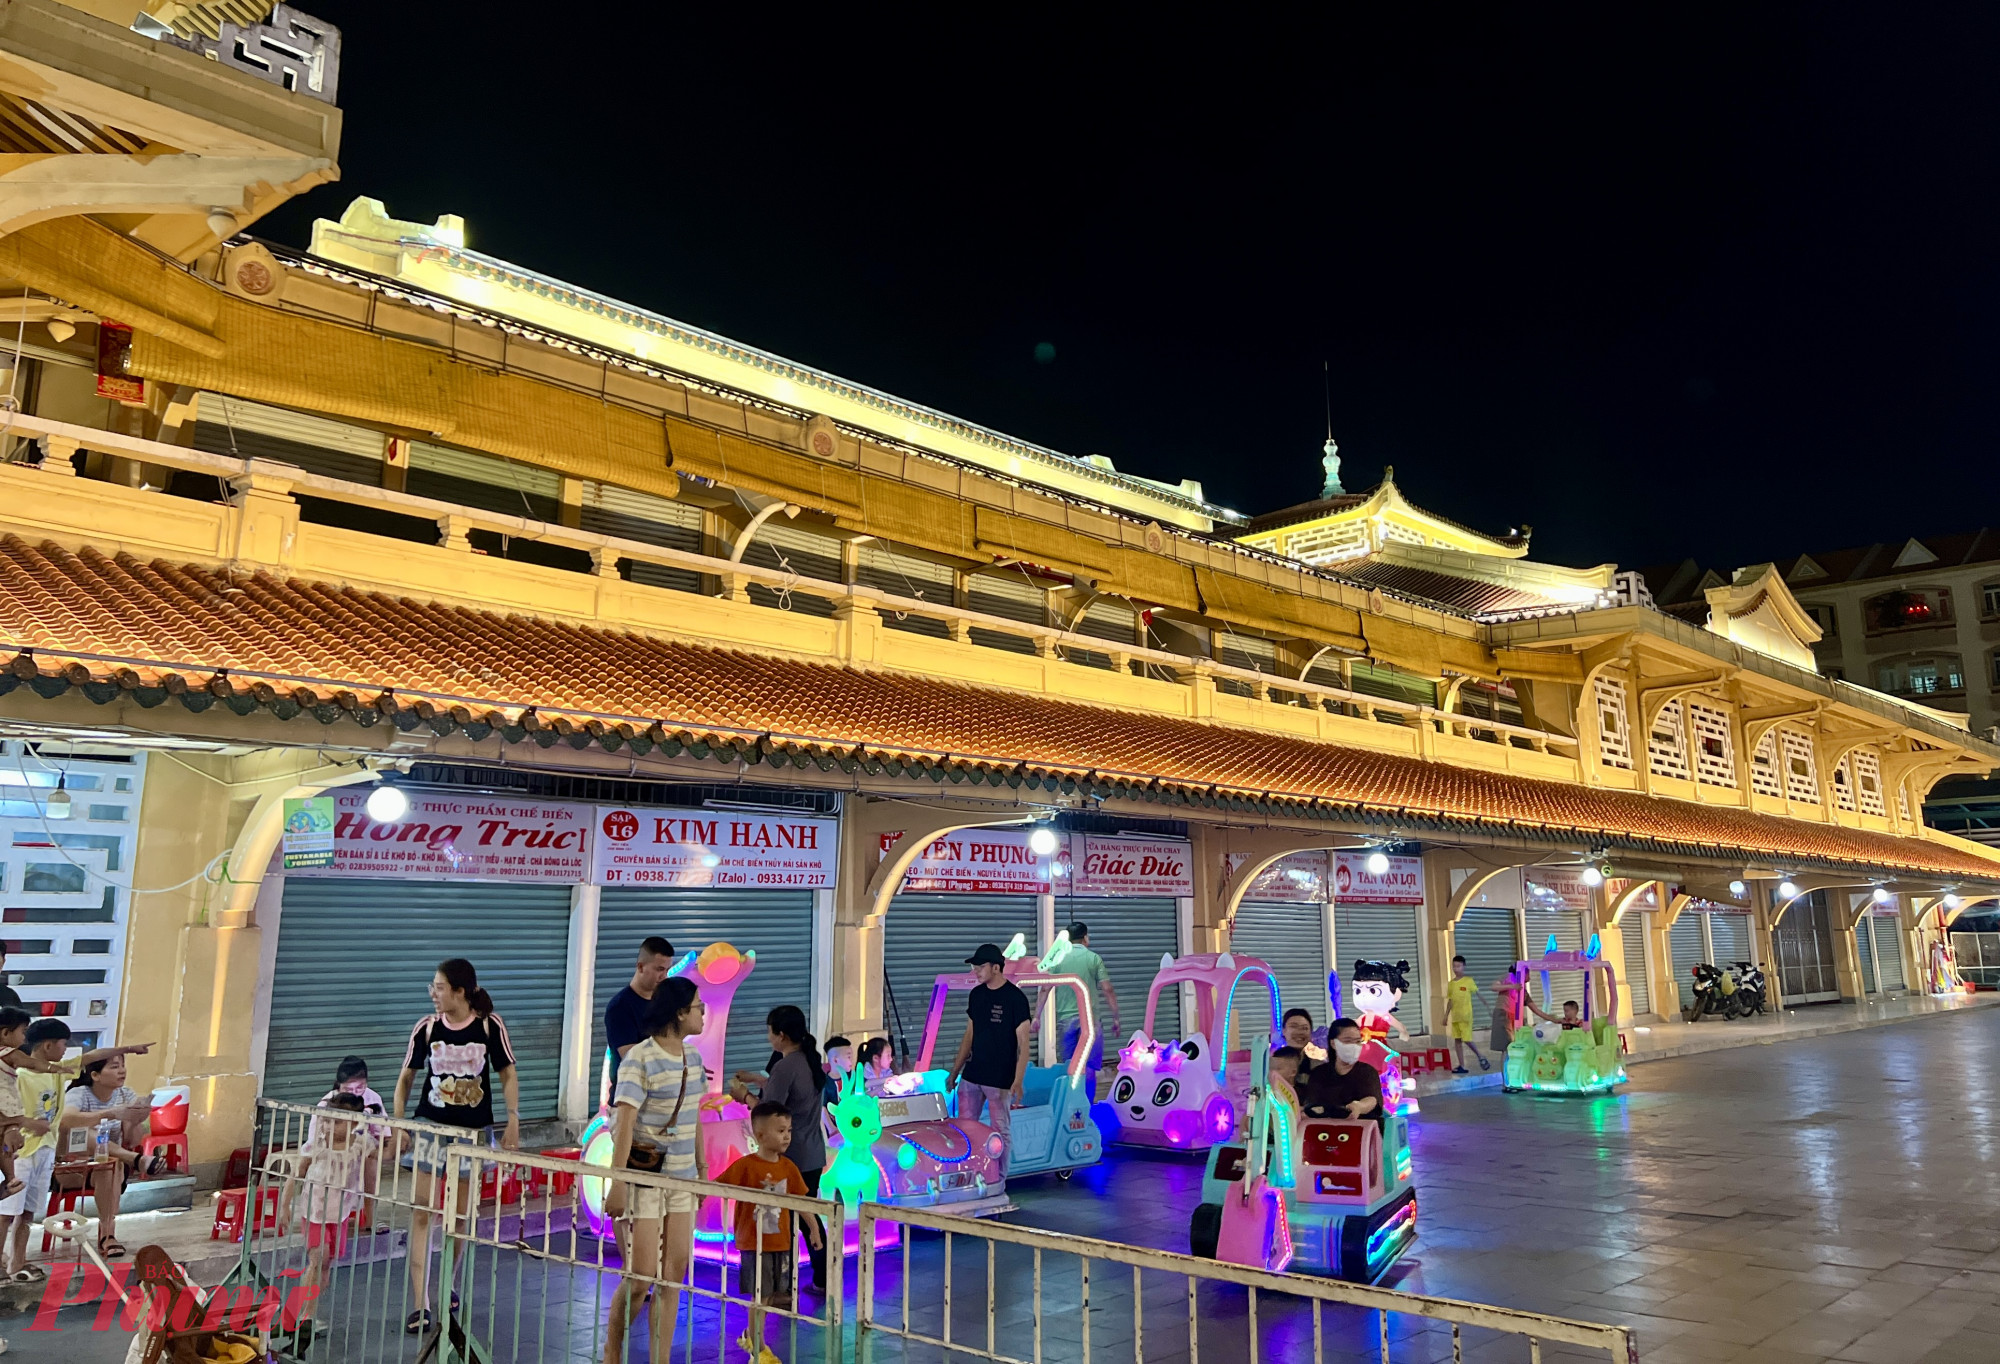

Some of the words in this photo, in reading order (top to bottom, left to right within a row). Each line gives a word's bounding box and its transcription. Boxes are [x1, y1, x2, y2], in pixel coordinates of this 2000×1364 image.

[422, 802, 462, 815] THỰC
[510, 806, 538, 818] CHẾ
[542, 808, 574, 820] BIẾN
[611, 814, 632, 824] SẠP
[478, 820, 578, 850] Trúc
[610, 824, 634, 838] 16
[652, 818, 719, 846] KIM
[728, 822, 818, 854] HẠNH
[614, 854, 644, 864] CHUYÊN
[646, 854, 660, 865] BÁN
[672, 858, 677, 866] &
[970, 843, 1038, 868] PHỤNG
[1084, 854, 1136, 876] Giác
[606, 870, 622, 880] ĐT
[718, 872, 747, 884] (Zalo)
